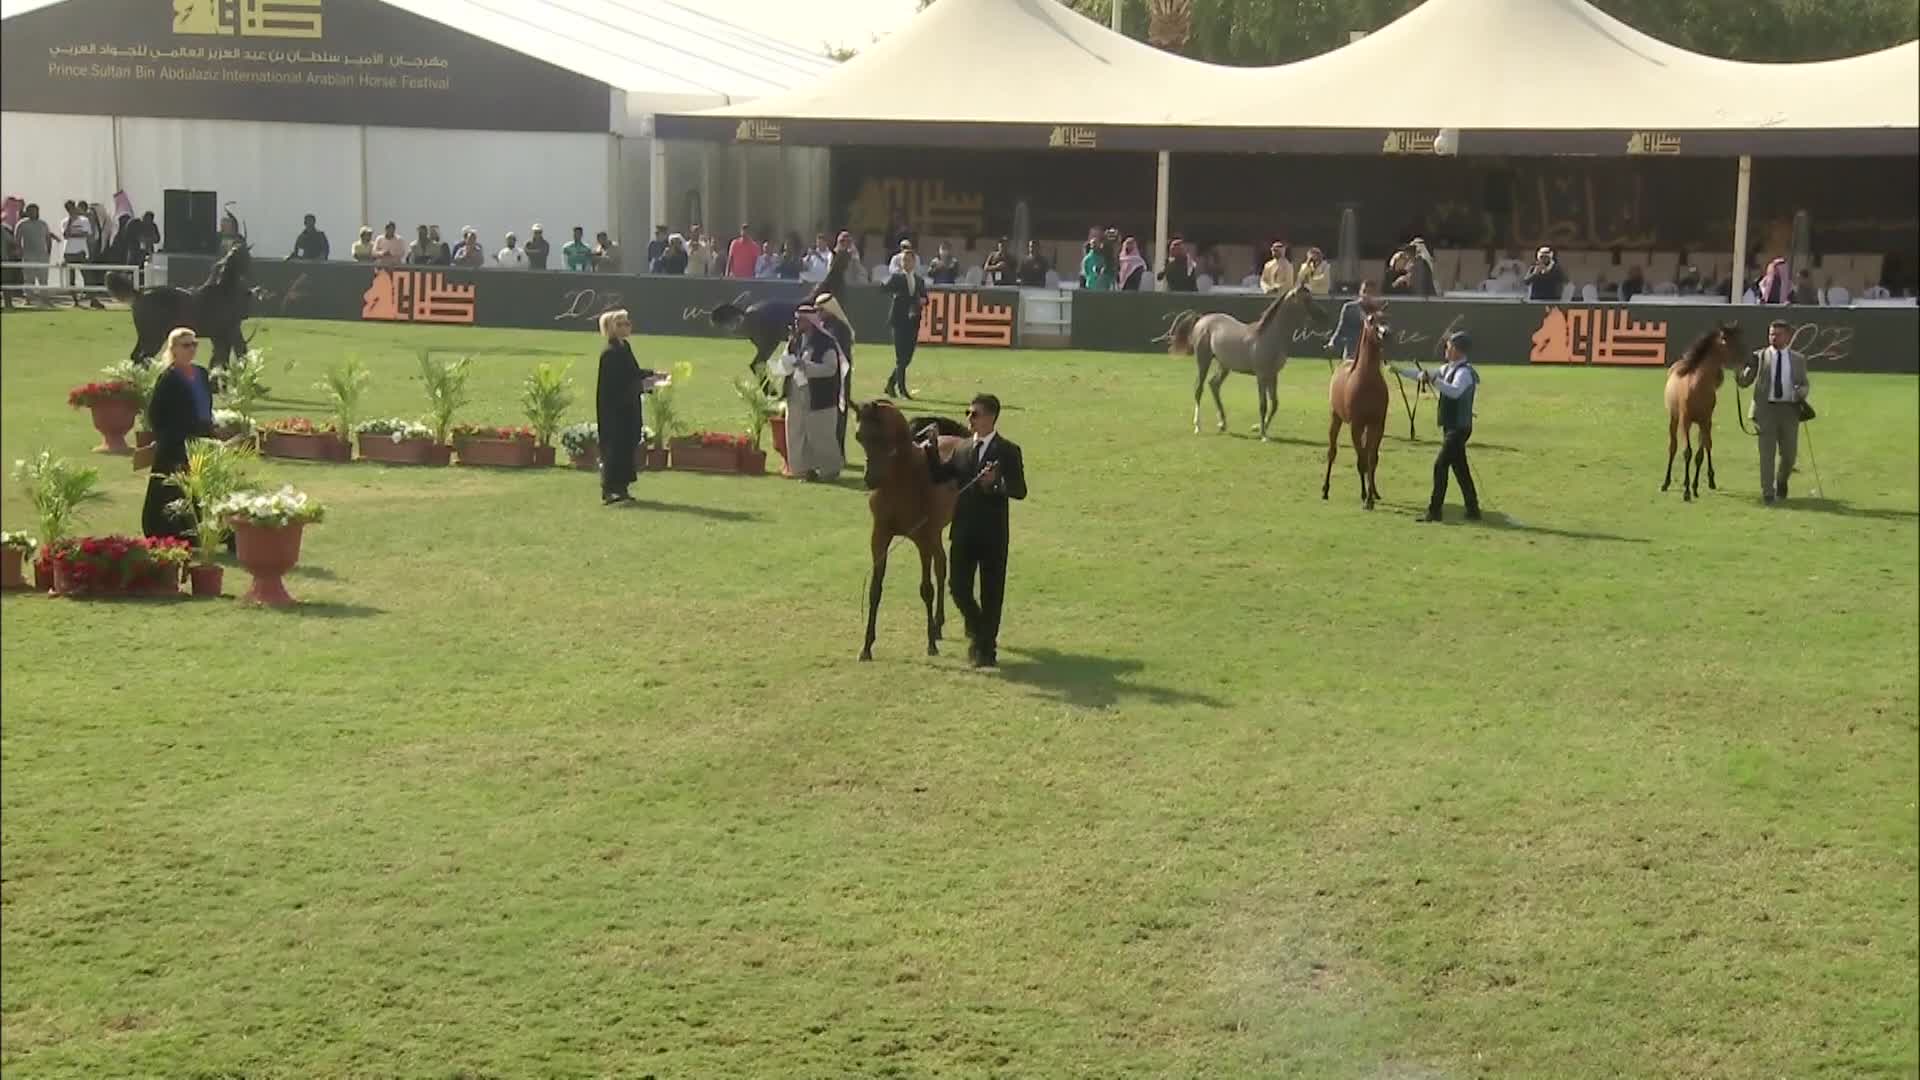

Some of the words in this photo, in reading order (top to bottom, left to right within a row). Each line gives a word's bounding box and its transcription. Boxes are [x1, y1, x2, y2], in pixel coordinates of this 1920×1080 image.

[48, 63, 88, 78] Prince
[91, 64, 131, 79] Sultan
[135, 64, 156, 80] Bin
[159, 65, 220, 81] Abdulaziz
[222, 68, 302, 83] International
[306, 71, 354, 86] Arabian
[359, 72, 398, 88] Horse
[401, 74, 449, 89] Festival
